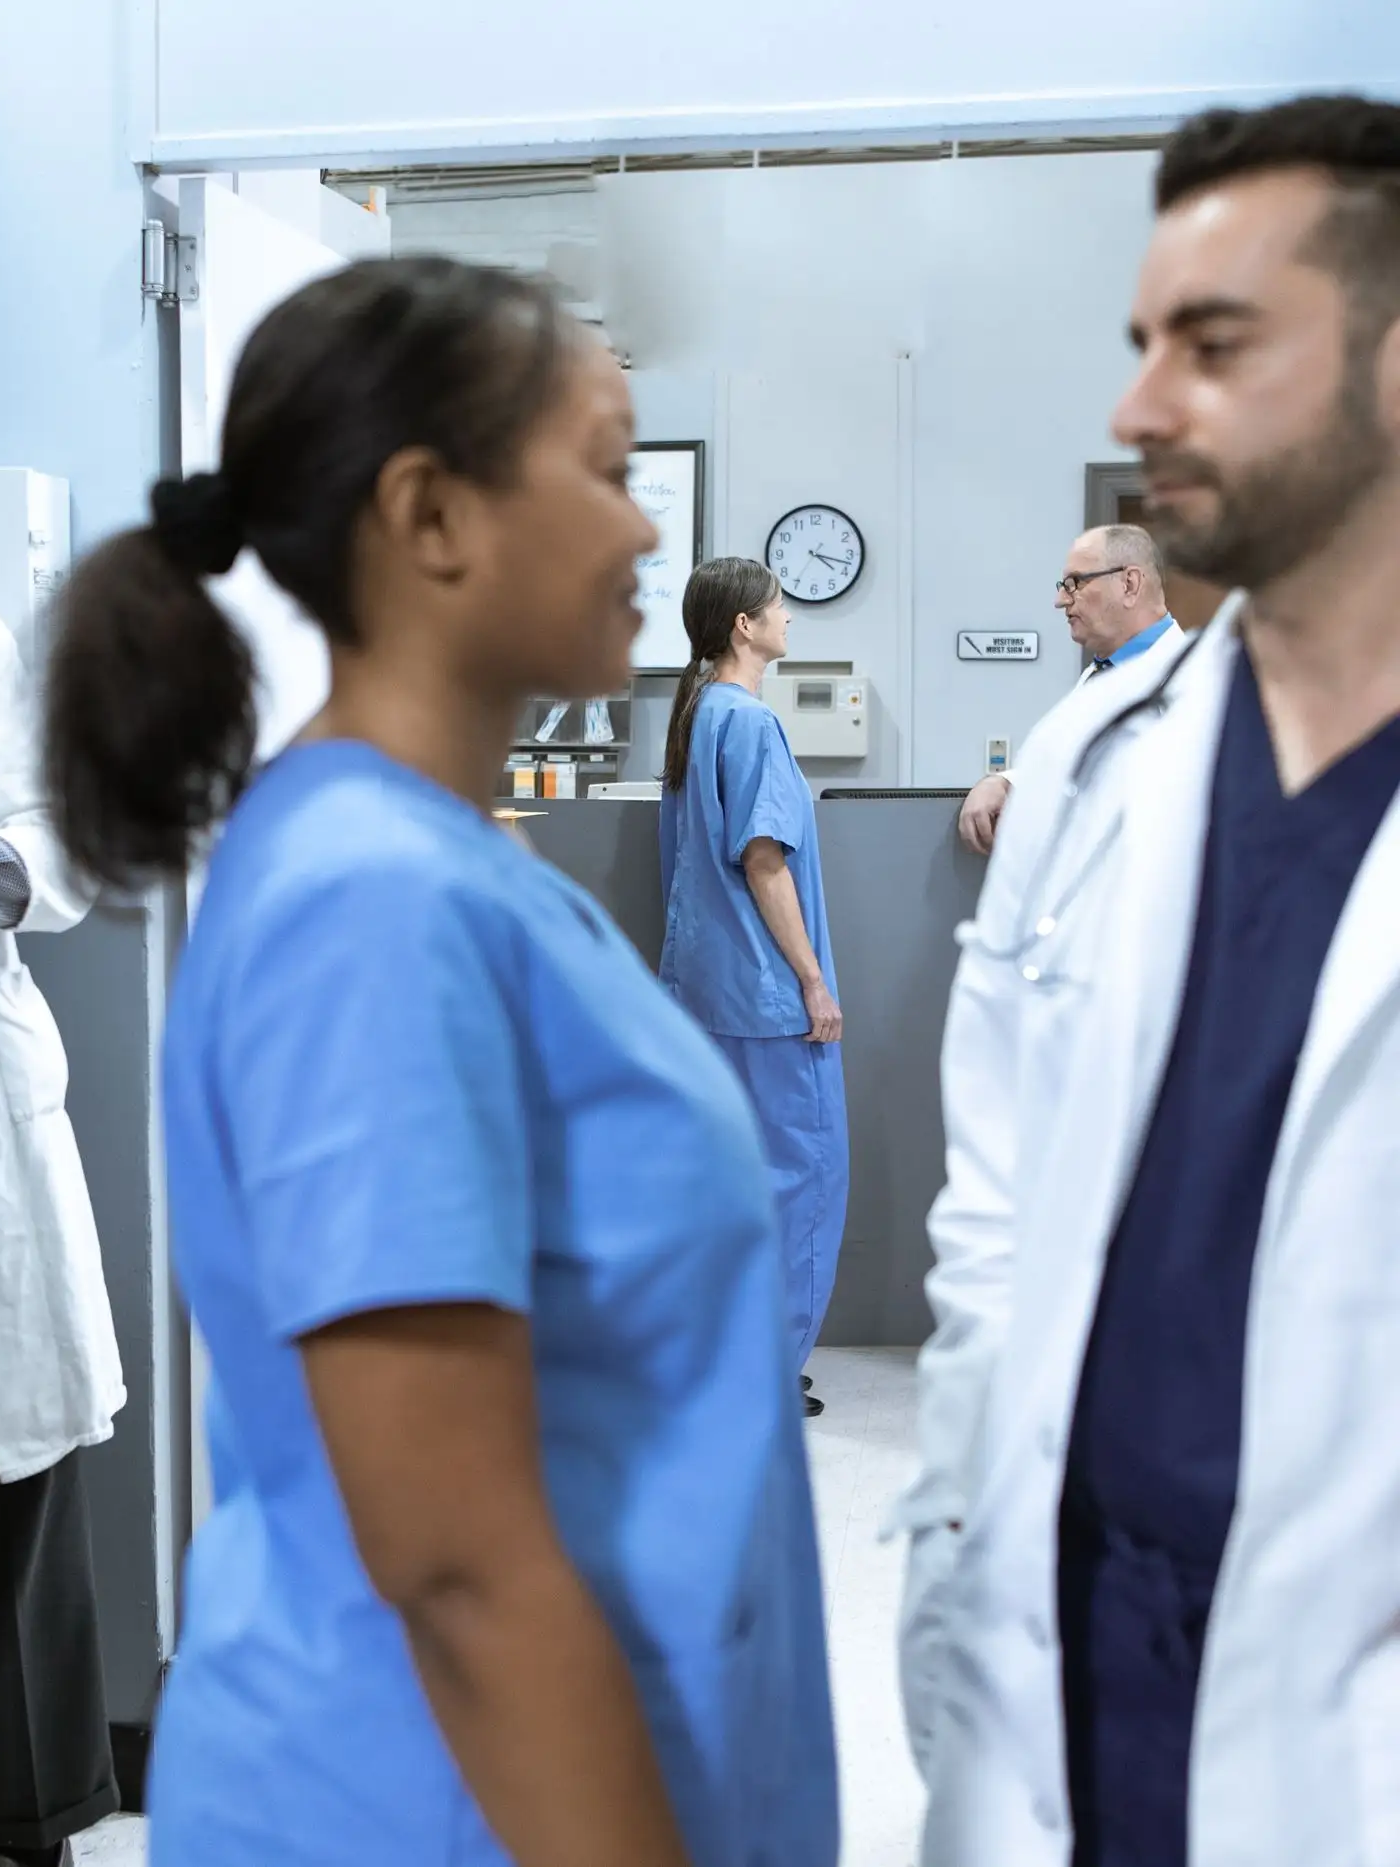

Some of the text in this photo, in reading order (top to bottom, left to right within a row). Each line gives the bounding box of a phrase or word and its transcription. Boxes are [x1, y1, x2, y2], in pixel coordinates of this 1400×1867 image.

[794, 519, 804, 531] 11
[809, 514, 821, 525] 12
[830, 519, 835, 530] 1
[780, 532, 791, 543] 10
[841, 531, 850, 542] 2
[775, 549, 784, 560] 9
[846, 549, 854, 560] 3
[780, 566, 788, 577] 8
[840, 566, 849, 576] 4
[793, 578, 801, 590] 7
[809, 583, 818, 595] 6
[827, 578, 836, 590] 5
[992, 638, 1025, 646] VISITORS
